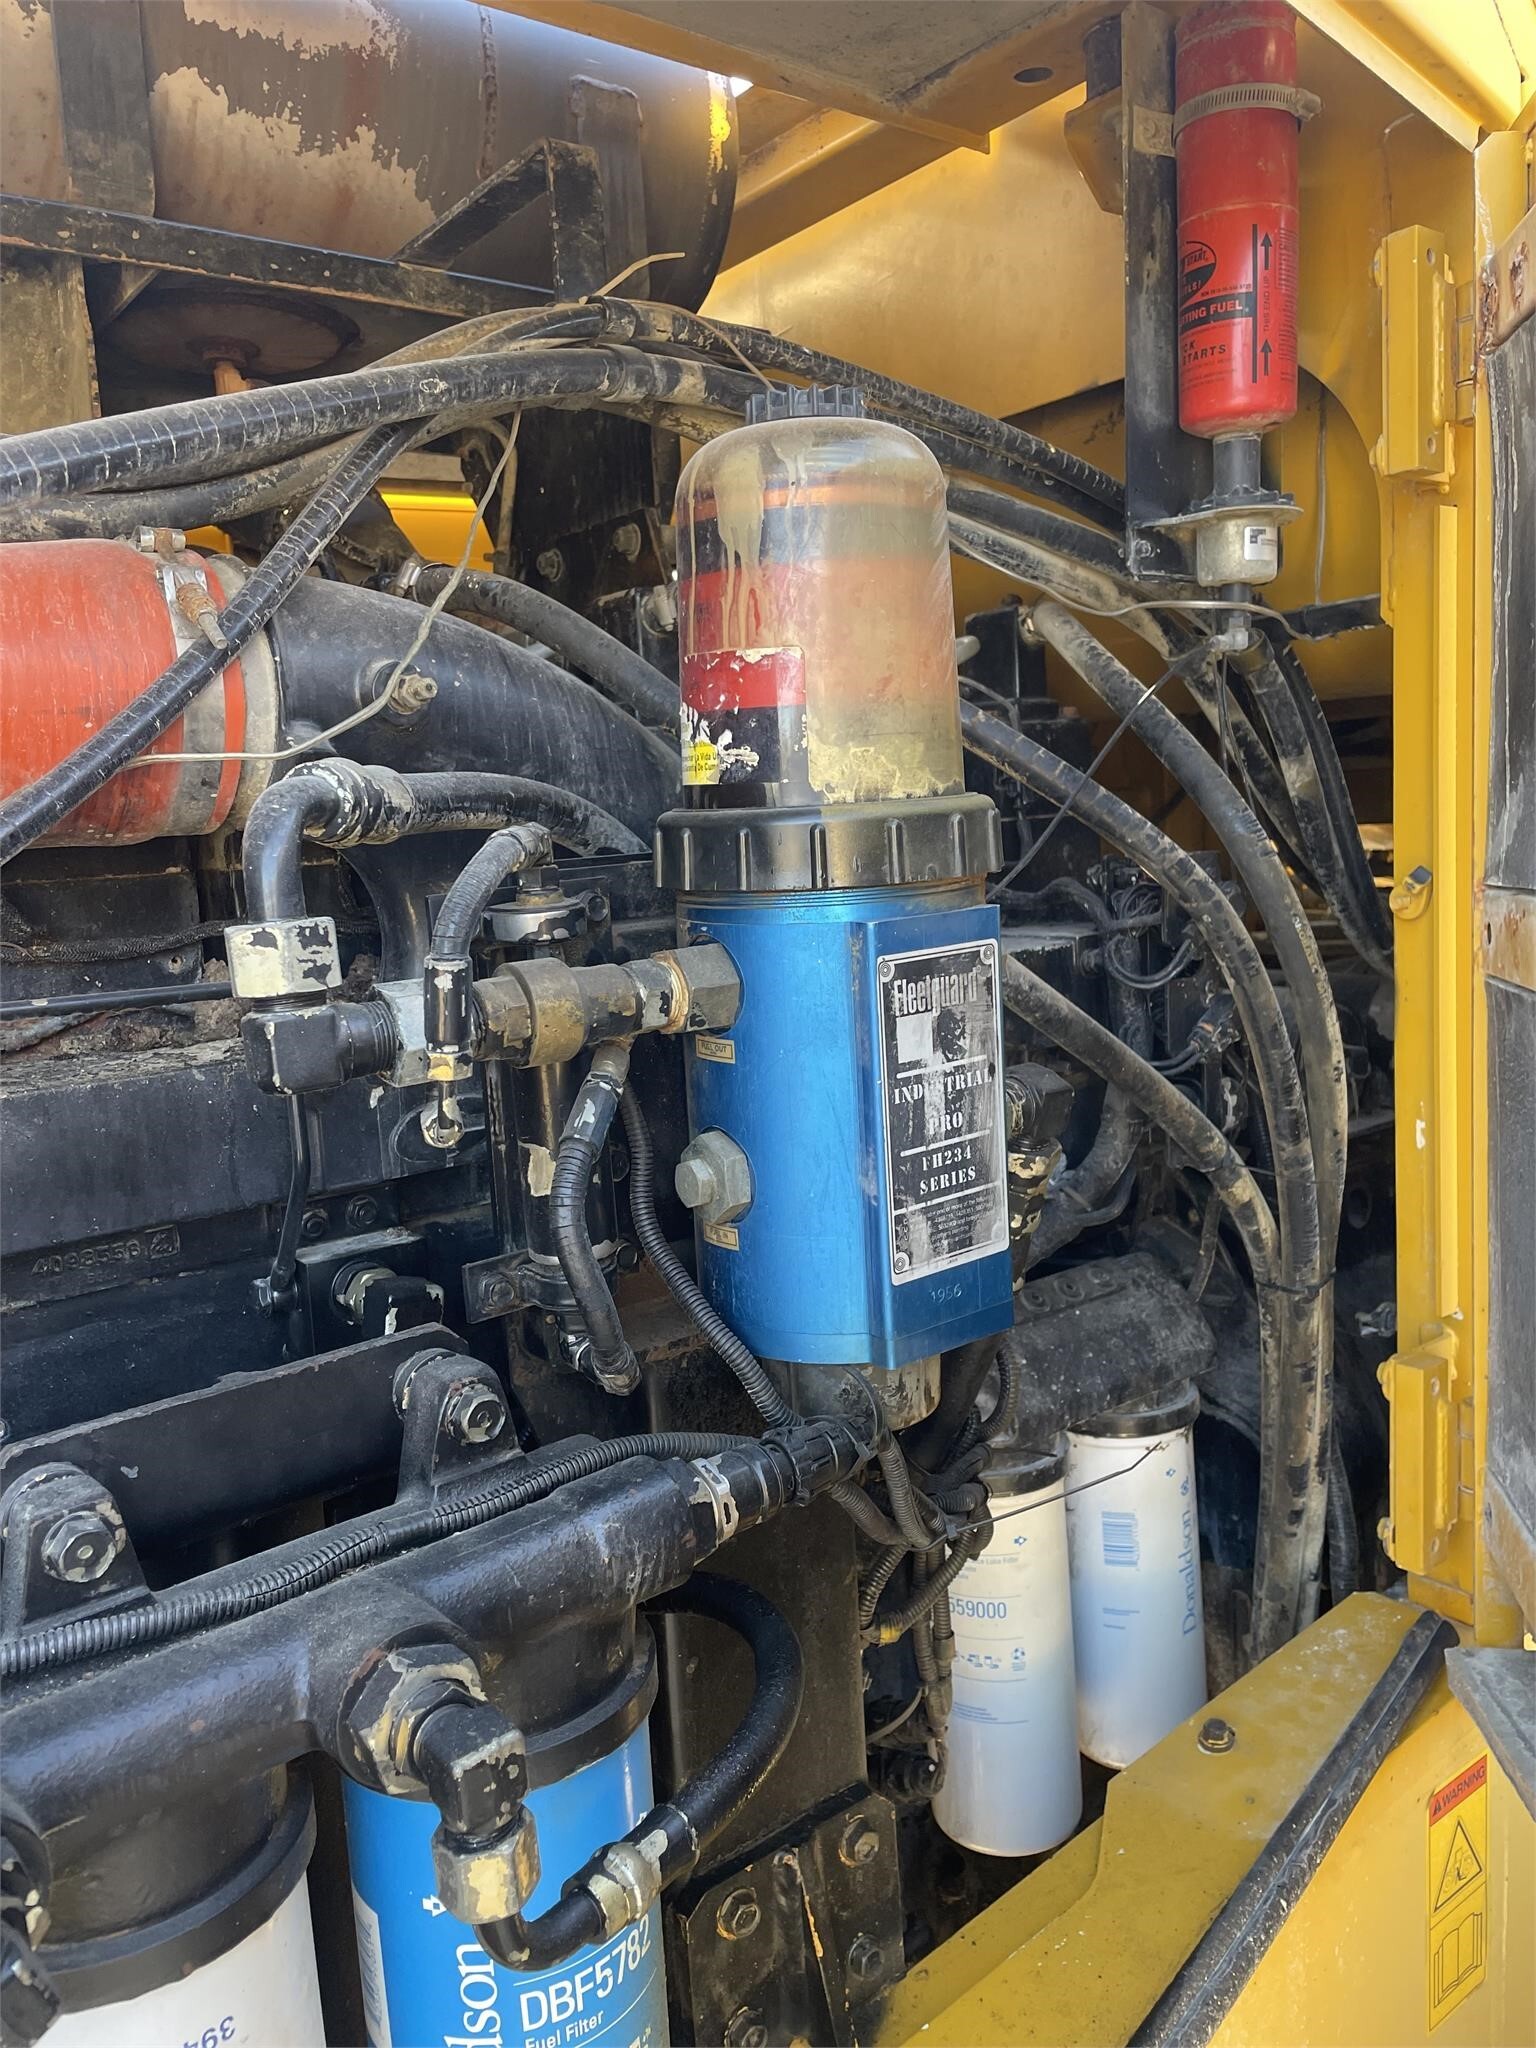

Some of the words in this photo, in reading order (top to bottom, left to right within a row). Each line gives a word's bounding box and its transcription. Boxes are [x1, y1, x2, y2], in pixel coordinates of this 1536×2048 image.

[1210, 300, 1243, 315] FUEL
[893, 970, 978, 1017] Fleetguard
[893, 1067, 993, 1106] INDTRIAL
[928, 1111, 964, 1136] PRO
[922, 1144, 972, 1172] FH234
[919, 1165, 977, 1195] SERIES
[1177, 1509, 1198, 1638] Donaldson
[1442, 1765, 1486, 1808] WARNING
[519, 1914, 652, 2033] DBF5782
[524, 2028, 561, 2048] Fuel
[565, 2009, 605, 2043] Filter
